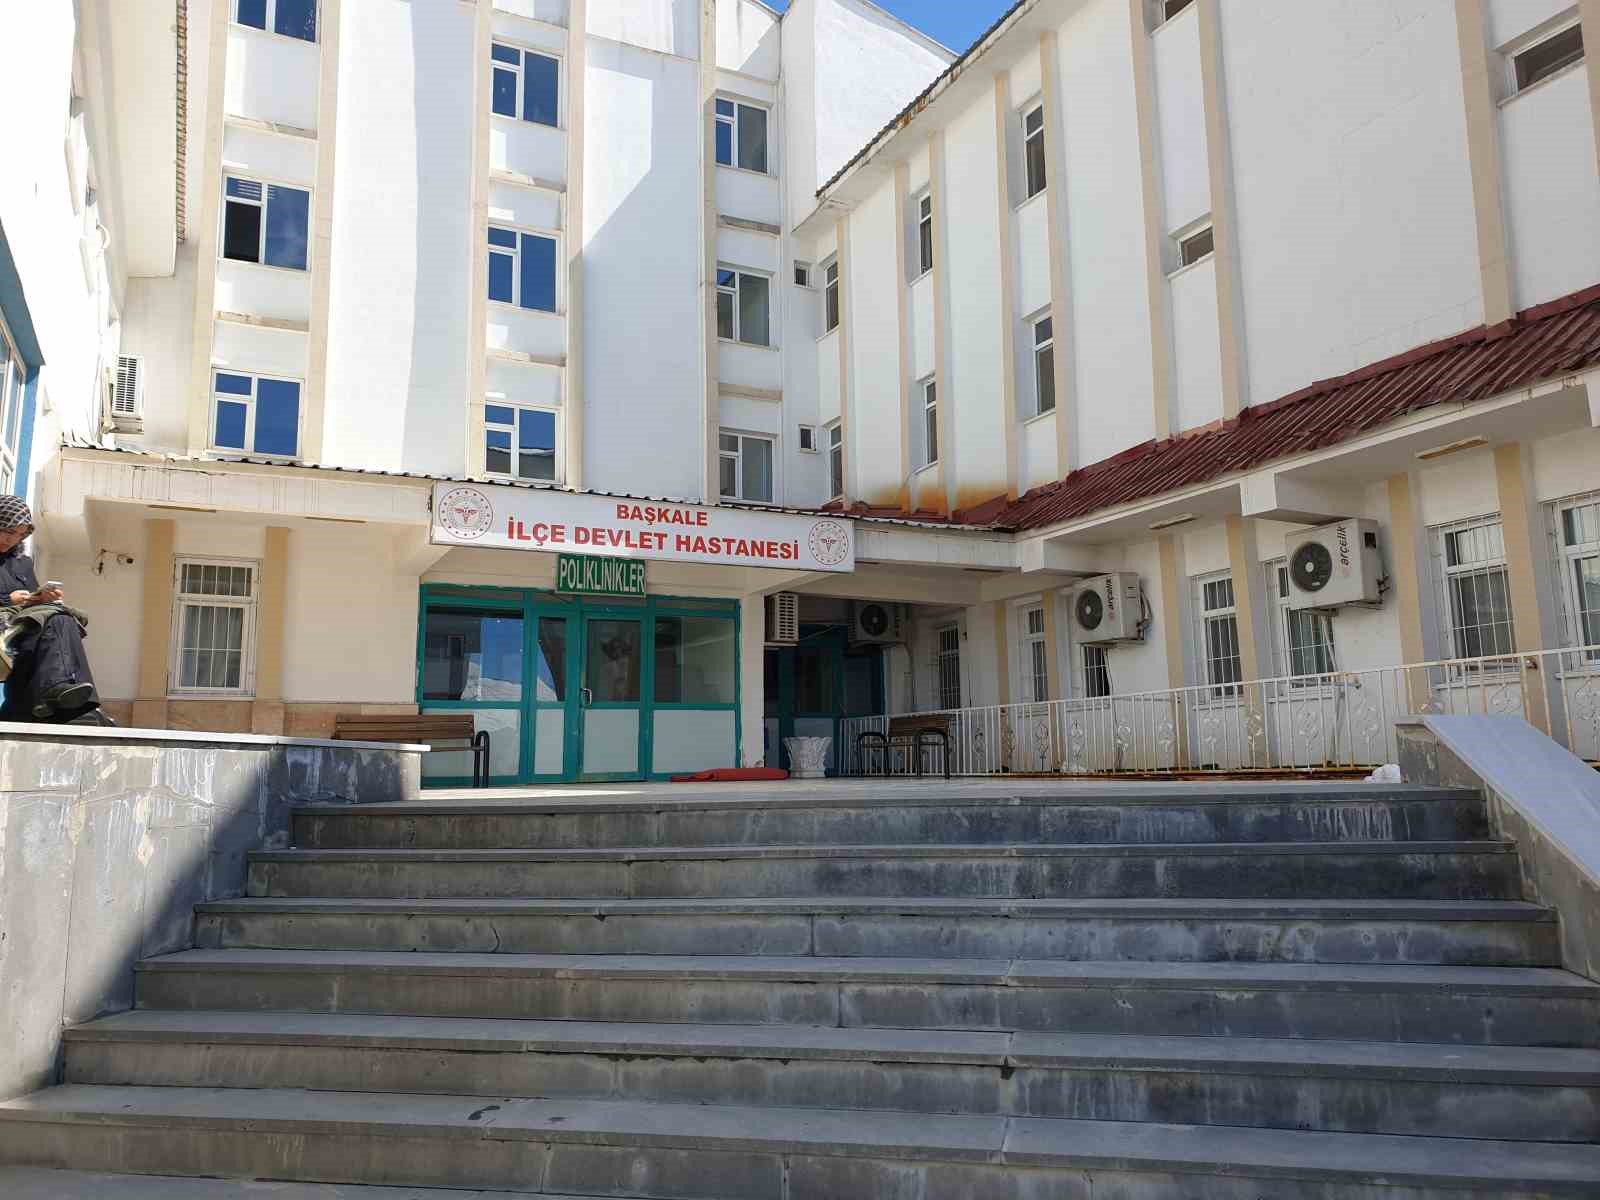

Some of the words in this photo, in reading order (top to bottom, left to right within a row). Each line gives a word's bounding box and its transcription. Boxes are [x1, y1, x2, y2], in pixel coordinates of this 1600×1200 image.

[616, 503, 708, 527] BAŞKALE
[507, 516, 565, 547] İLÇE
[574, 527, 668, 552] DEVLET
[675, 535, 799, 561] HASTANESİ
[559, 555, 646, 594] POLİKLİNİKLER
